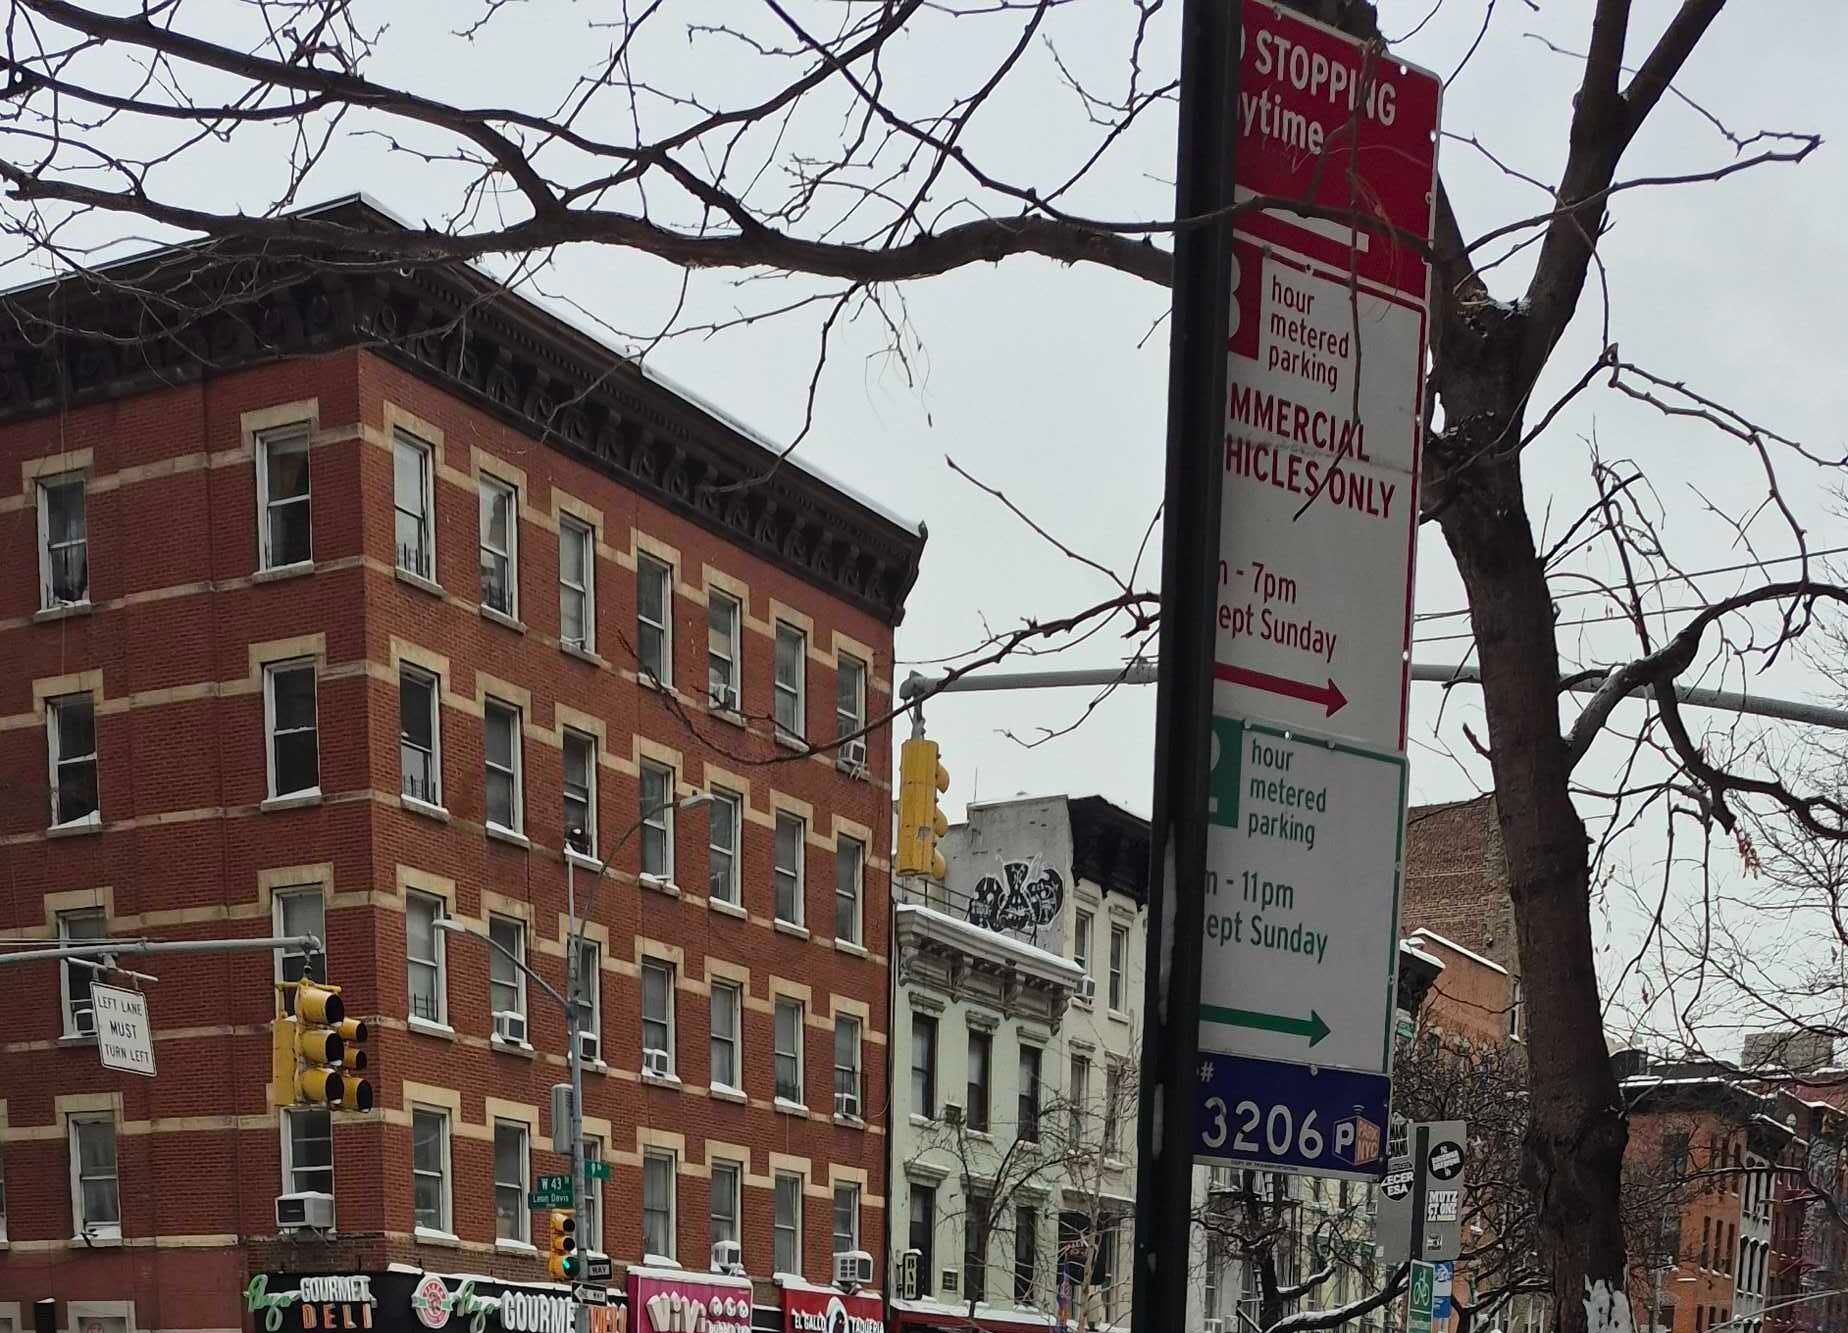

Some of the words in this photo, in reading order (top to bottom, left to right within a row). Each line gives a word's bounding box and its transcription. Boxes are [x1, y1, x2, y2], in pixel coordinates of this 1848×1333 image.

[1254, 30, 1397, 127] STOPPING
[1237, 88, 1325, 156] ytime
[1271, 274, 1315, 316] hour
[1270, 312, 1350, 360] metered
[1268, 345, 1339, 393] parking
[1230, 382, 1370, 463] MMERCIAL
[1225, 433, 1320, 498] HICLES
[1327, 466, 1397, 519] ONLY
[1252, 560, 1297, 605] 7pm
[1218, 603, 1254, 639] ept
[1260, 607, 1337, 664] Sunday
[1251, 736, 1294, 771] hour
[1249, 777, 1327, 813] metered
[1248, 810, 1316, 851] parking
[1241, 869, 1294, 911] 11pm
[1206, 911, 1243, 947] ept
[1250, 914, 1328, 965] Sunday
[97, 995, 117, 1010] LEFT
[121, 1000, 143, 1016] LANE
[109, 1020, 137, 1040] MUST
[104, 1043, 127, 1059] TURN
[129, 1049, 149, 1062] LEFT
[1202, 1096, 1324, 1159] 3206
[1334, 1121, 1355, 1155] P
[540, 1178, 549, 1190] W
[551, 1177, 562, 1190] 43
[300, 1275, 373, 1303] GOURMET
[592, 1265, 606, 1275] WAY
[302, 1303, 373, 1329] DELI
[803, 1313, 826, 1332] GALLO
